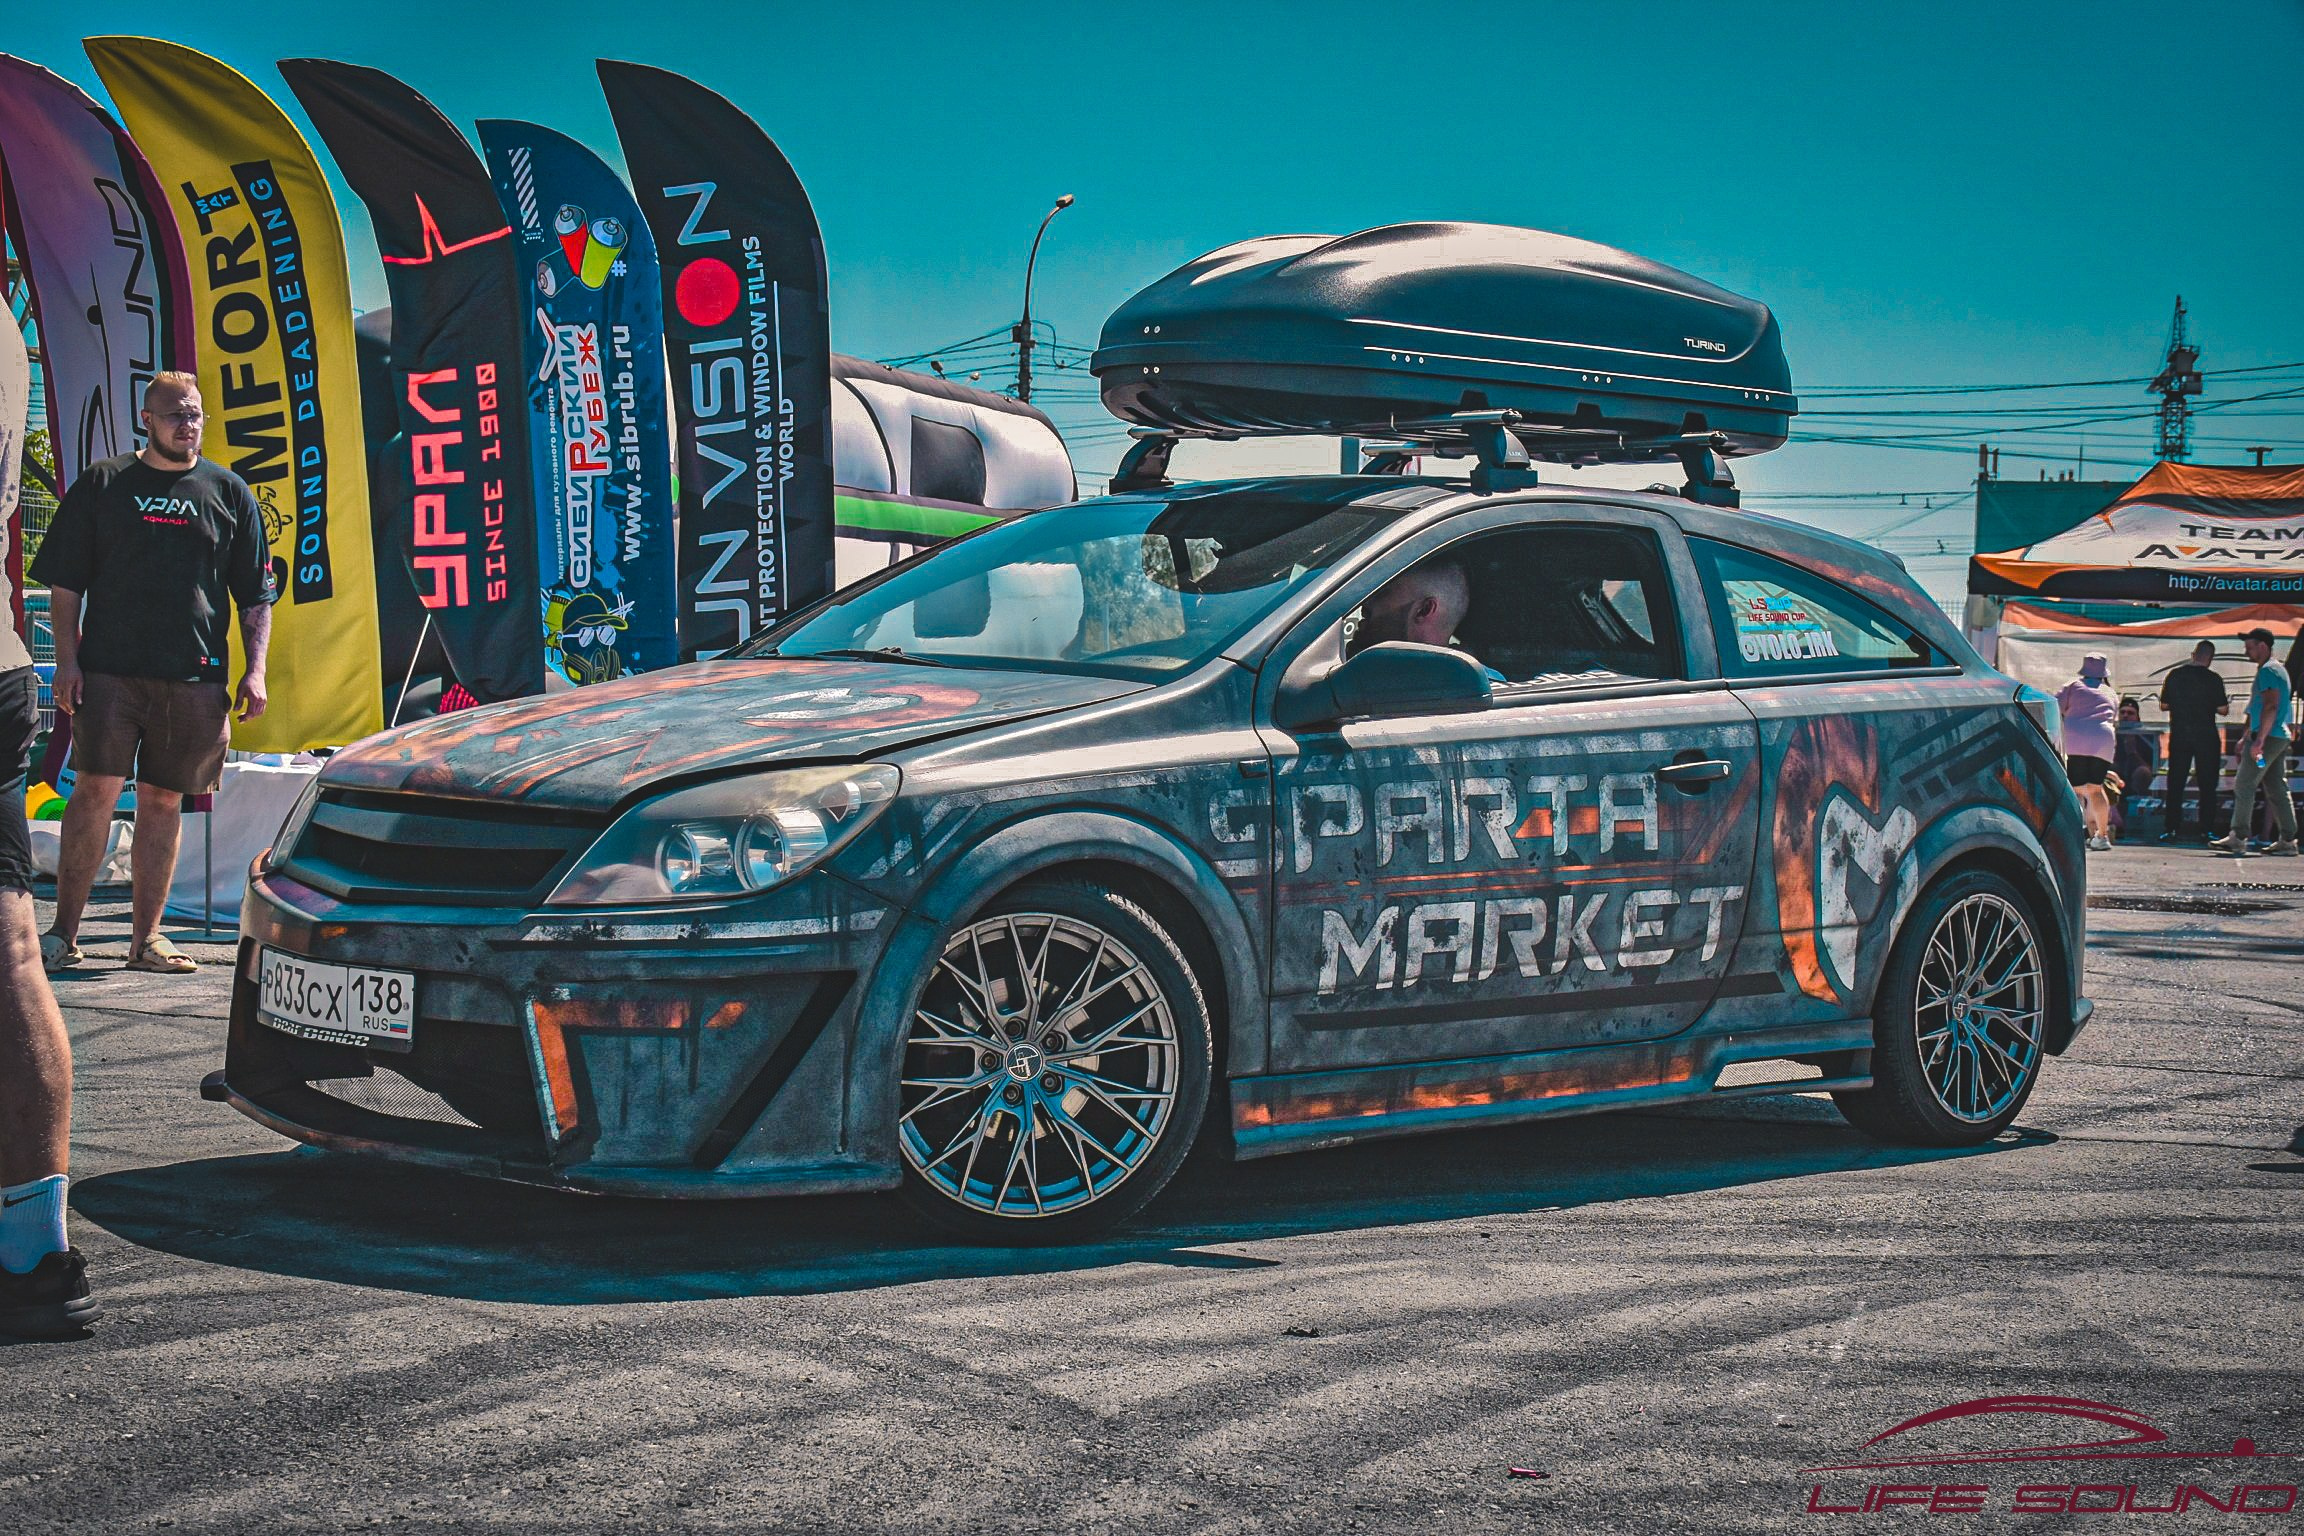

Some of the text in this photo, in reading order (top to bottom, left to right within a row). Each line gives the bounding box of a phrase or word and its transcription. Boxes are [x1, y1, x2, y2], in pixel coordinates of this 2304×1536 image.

[742, 236, 767, 304] FILMS
[750, 311, 772, 419] WINDOW
[1683, 337, 1726, 353] TURINO
[250, 178, 323, 584] SOUND DEADENING
[612, 325, 642, 562] www.sibrub.ru
[754, 421, 773, 441] &
[778, 398, 795, 482] WORLD
[134, 495, 198, 516] УРАЛ
[475, 362, 507, 602] SINCE 1900
[143, 515, 189, 525] КОМАНДА
[755, 446, 776, 598] PROTECTION
[2180, 524, 2304, 540] TEAM
[1747, 612, 1764, 622] LIFE
[1765, 612, 1790, 622] SOUND
[1209, 772, 1660, 878] SPARTA
[1317, 885, 1745, 997] MARKET
[352, 974, 403, 1015] 138
[362, 1015, 389, 1032] RUS
